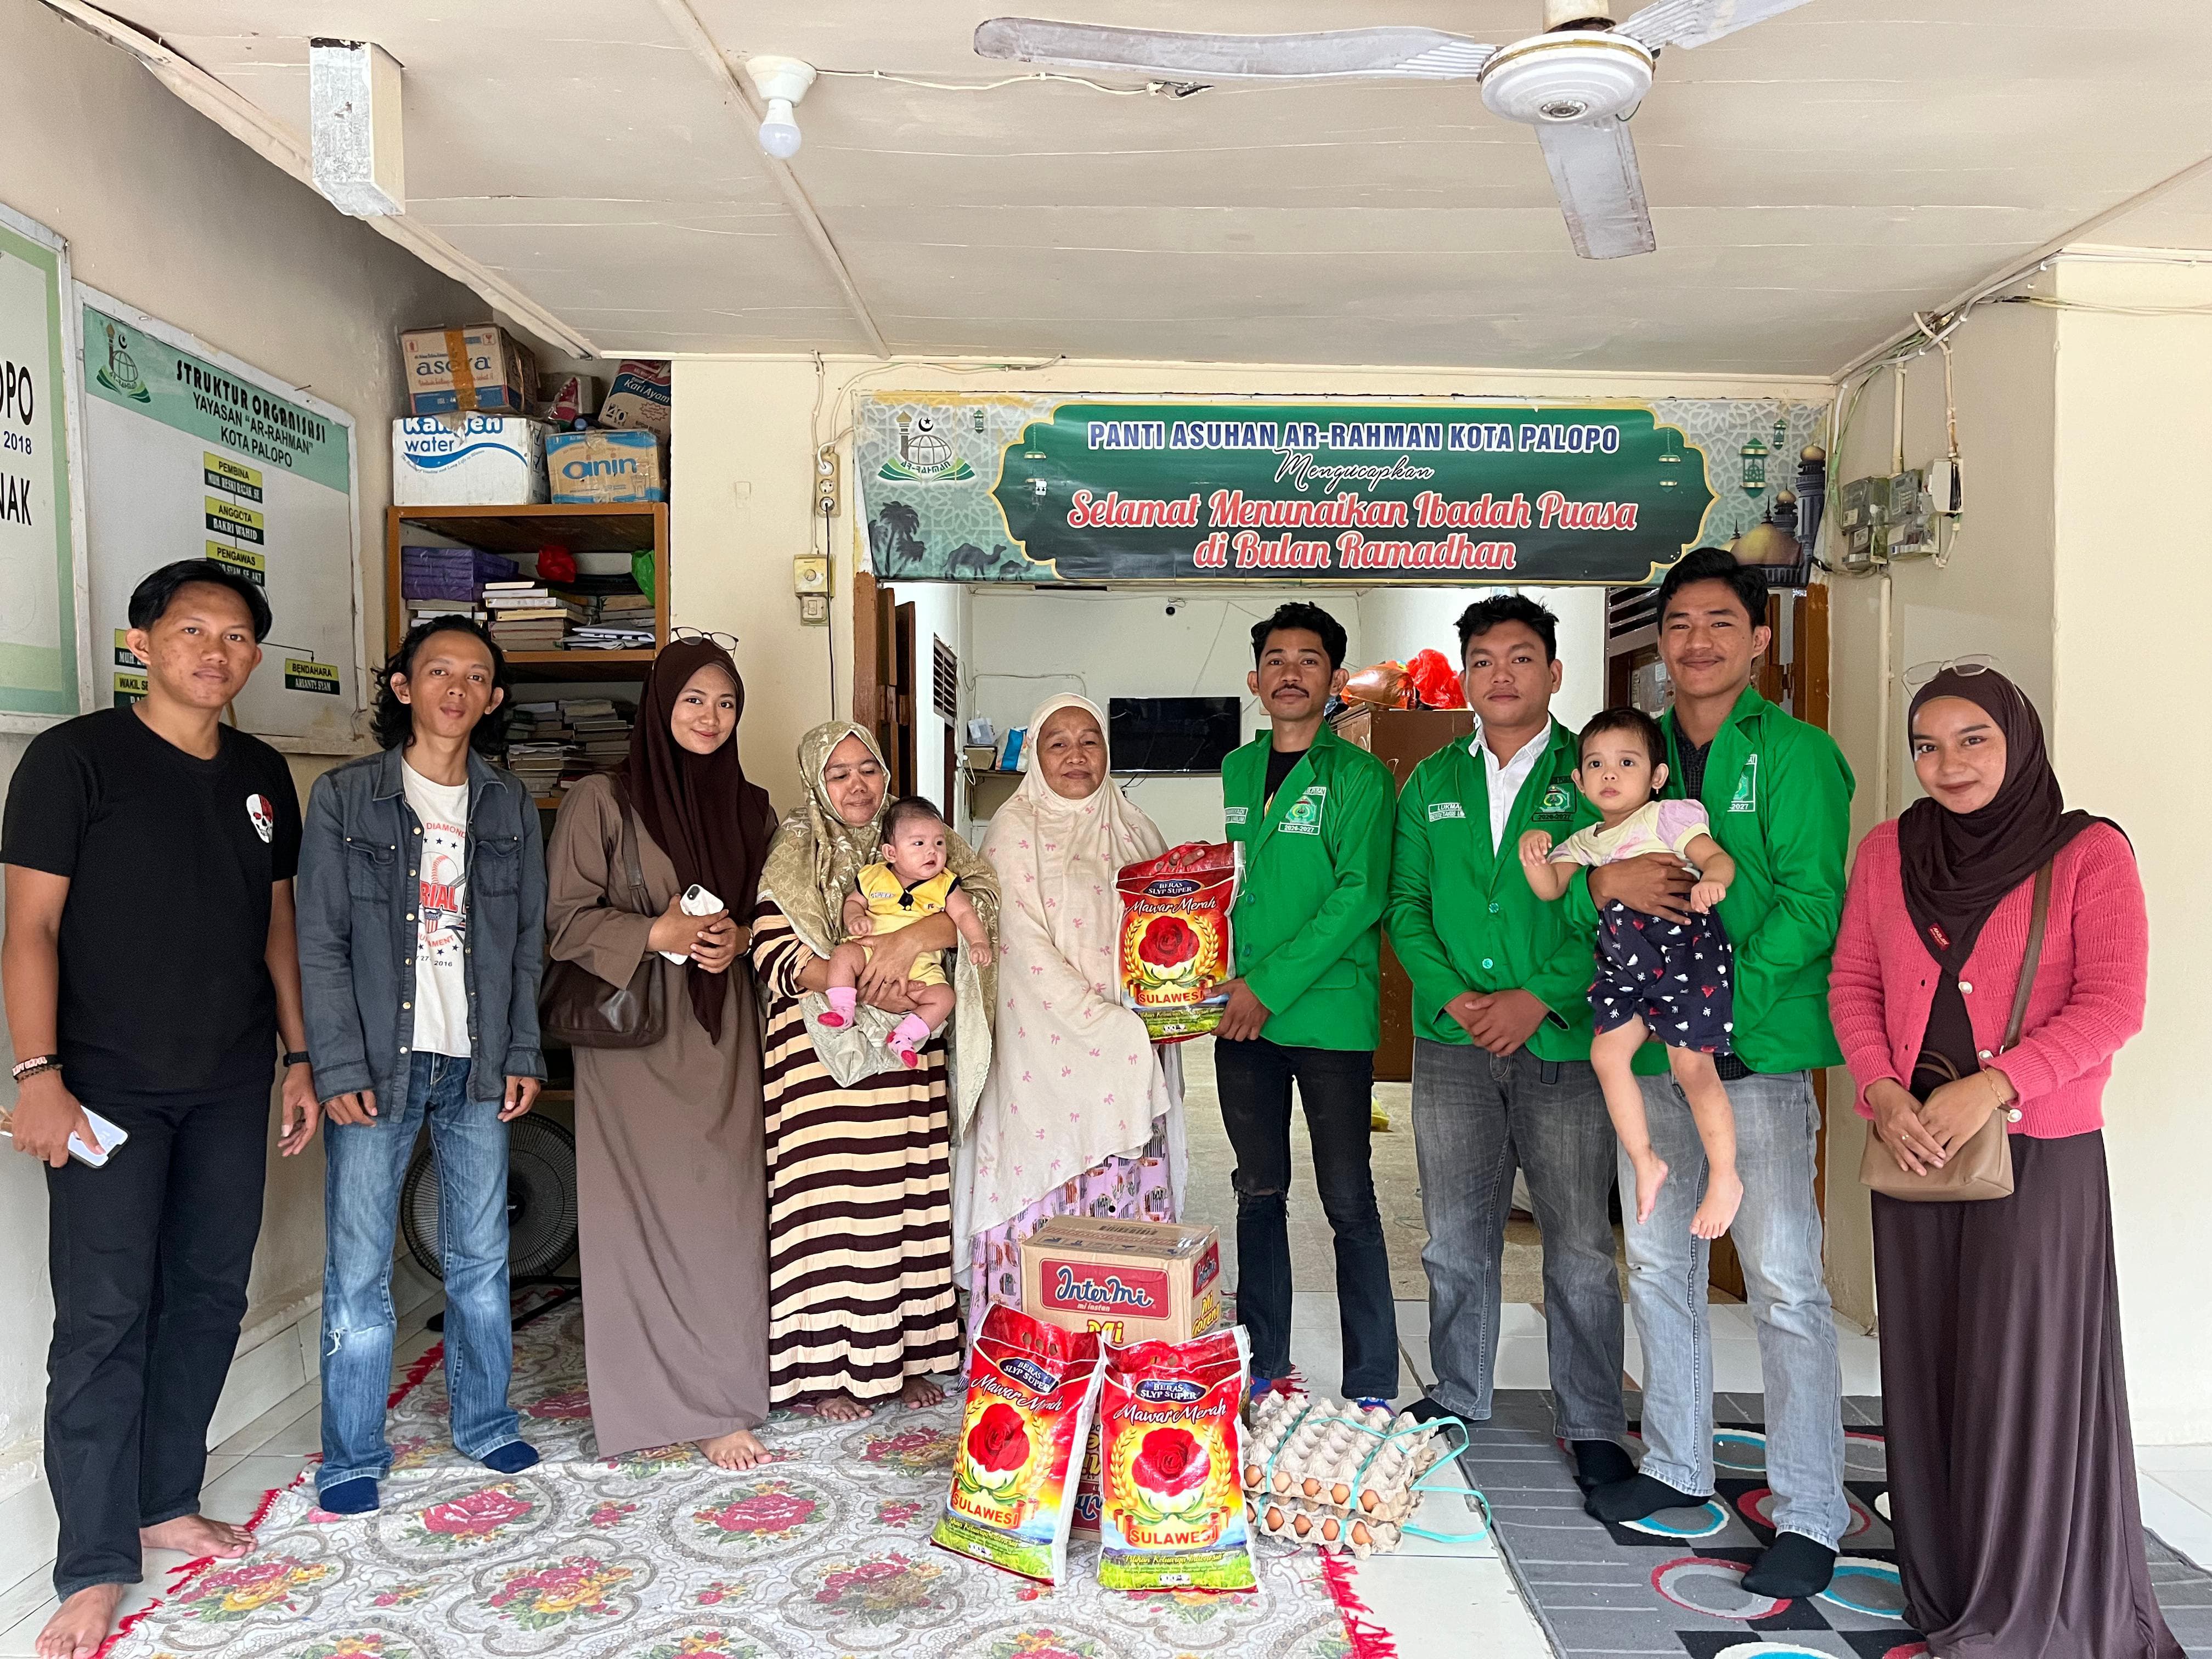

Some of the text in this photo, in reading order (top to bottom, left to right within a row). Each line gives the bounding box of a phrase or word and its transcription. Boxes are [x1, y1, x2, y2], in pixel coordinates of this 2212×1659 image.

[0, 360, 33, 426] PO
[177, 360, 325, 443] STRUKTUR ORGANISASI
[624, 379, 646, 393] Kari
[643, 388, 670, 403] Ayam
[193, 392, 242, 427] YAYASAN
[4, 431, 32, 455] 2018
[221, 426, 292, 467] KOTA PALOPO
[405, 437, 454, 452] water
[1089, 422, 1620, 452] PANTI ASUHAN AR-RAHMAN KOTA PALOPO
[218, 461, 250, 481] PEMBINA
[1274, 449, 1434, 492] Mengucapkan
[218, 504, 252, 523] ANGGOTA
[1068, 489, 1639, 531] Selamat Menunaikan Ibadah Puasa
[213, 517, 257, 540] BAKRI WAHID
[217, 547, 256, 566] PENGAWAS
[1193, 529, 1517, 570] di Bulan Ramadhan
[292, 663, 332, 678] BENDAHARA
[119, 678, 140, 690] WAKIL
[1167, 886, 1192, 894] SUPER
[1126, 896, 1216, 916] Mawar Merah
[1138, 990, 1204, 1003] SULAWESI
[1056, 1265, 1154, 1308] InterMi
[1201, 1290, 1213, 1316] Mi
[1087, 1319, 1124, 1344] Mi
[1192, 1301, 1220, 1338] Goreng
[1017, 1361, 1042, 1379] BERAS
[970, 1374, 1023, 1400] Mawar
[1023, 1372, 1051, 1393] SUPER
[1153, 1383, 1184, 1392] BERAS
[1164, 1390, 1197, 1400] SUPER
[1113, 1403, 1173, 1426] Mawar
[1172, 1397, 1227, 1425] Merah
[952, 1492, 1019, 1526] SULAWESI
